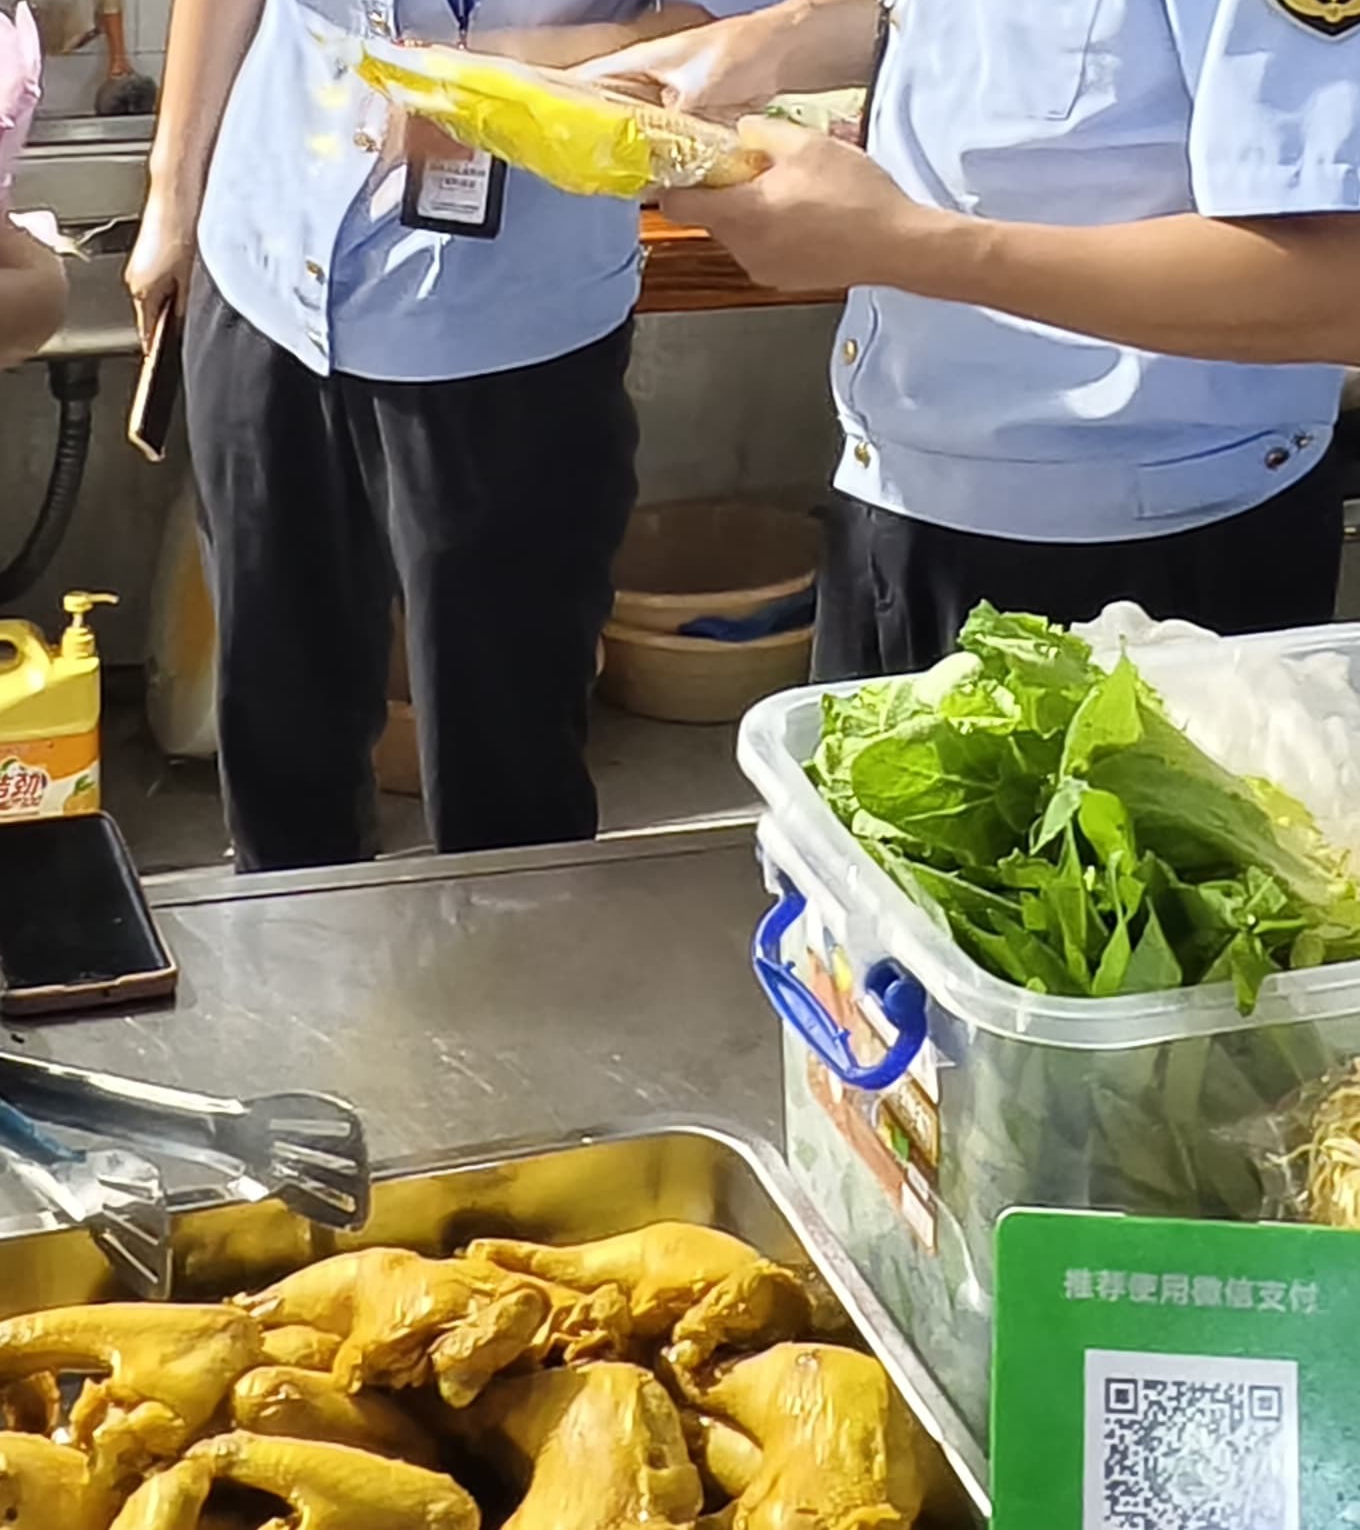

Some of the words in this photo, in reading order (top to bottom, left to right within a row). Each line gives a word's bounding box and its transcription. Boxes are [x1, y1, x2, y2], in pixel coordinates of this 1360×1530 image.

[1063, 1267, 1320, 1314] 推荐使用微信支付
